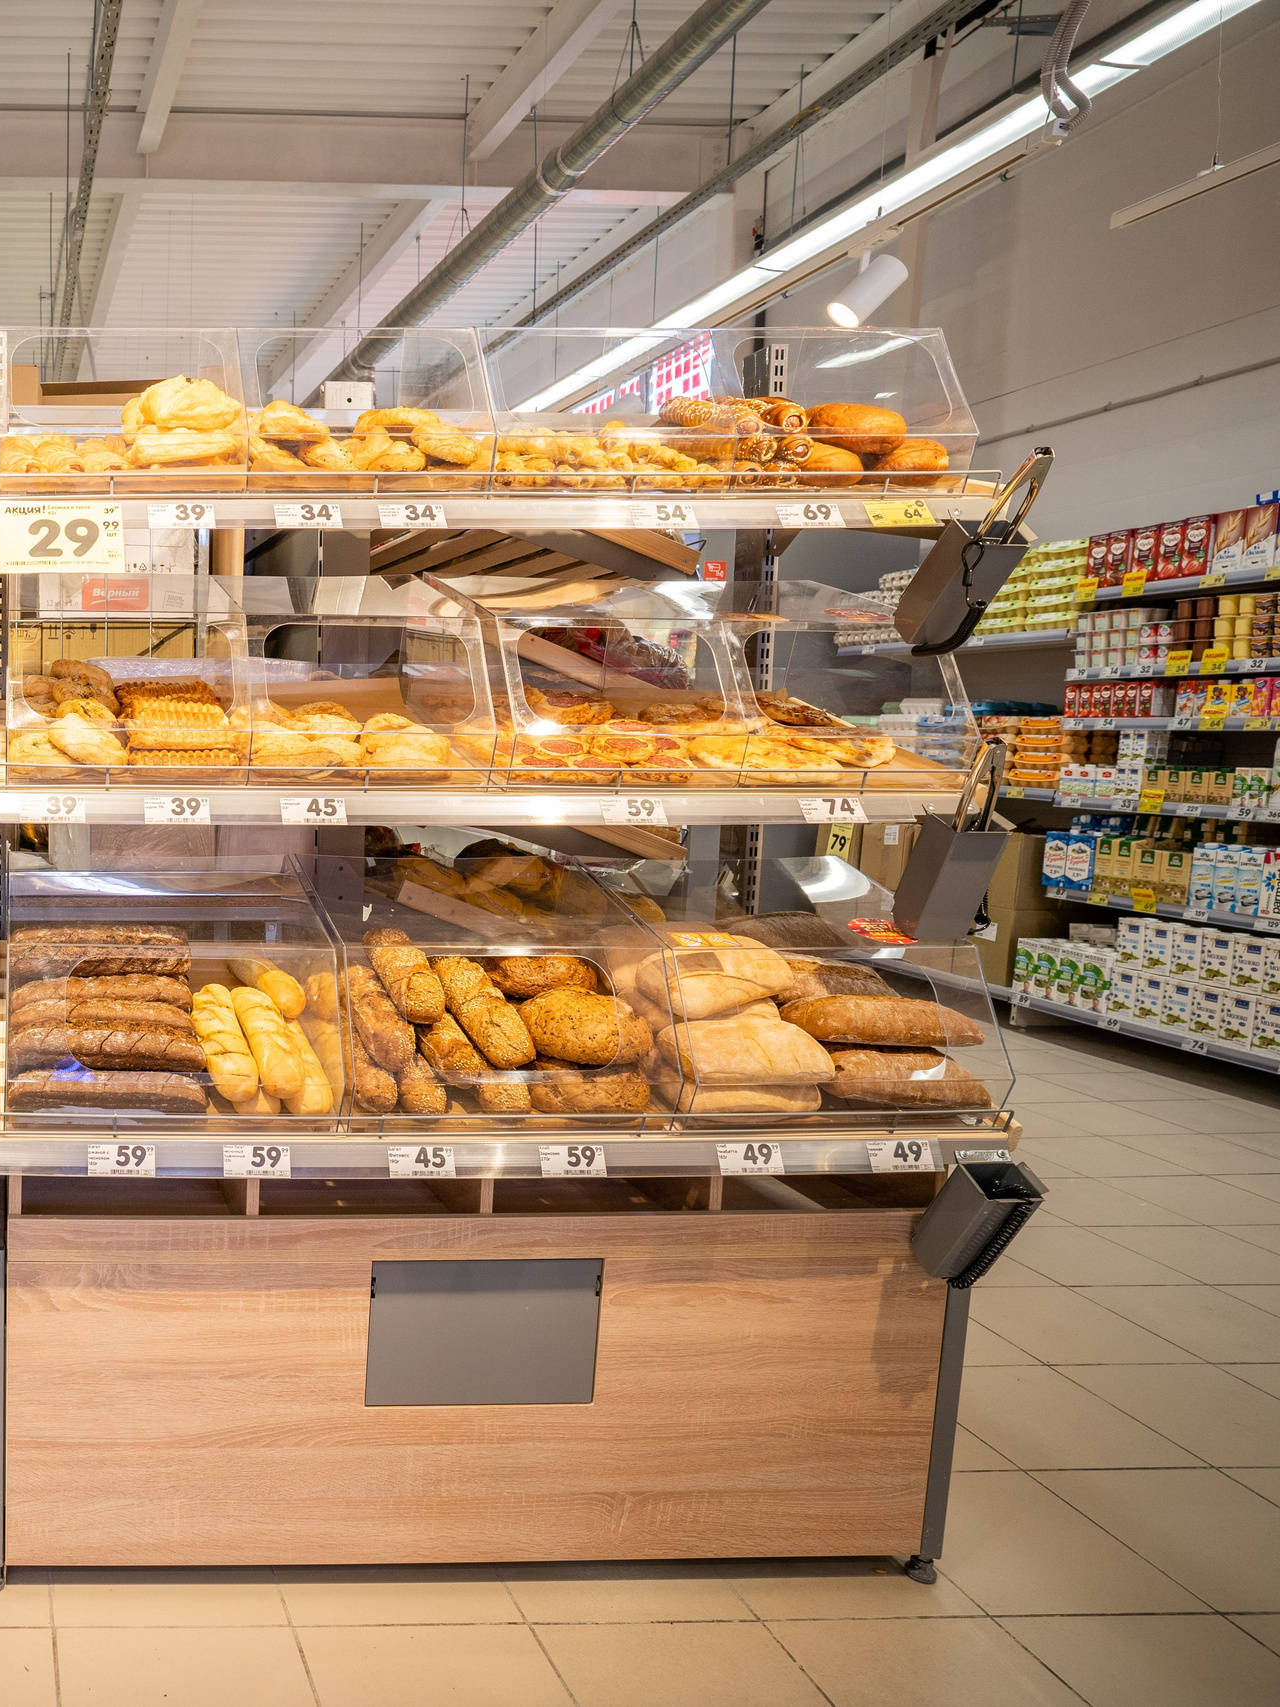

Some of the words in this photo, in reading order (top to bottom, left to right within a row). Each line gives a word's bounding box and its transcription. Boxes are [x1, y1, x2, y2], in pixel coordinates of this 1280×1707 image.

[5, 506, 46, 515] АКЦИЯ!
[175, 504, 206, 520] 39
[300, 504, 332, 520] 34
[404, 504, 436, 520] 34
[656, 504, 686, 521] 54
[803, 504, 832, 520] 69
[904, 508, 922, 518] 64
[103, 521, 119, 530] 99
[28, 518, 100, 557] 29
[92, 587, 140, 598] Верный
[1140, 666, 1151, 674] 32
[1250, 660, 1264, 668] 32
[46, 796, 76, 814] 39
[170, 798, 200, 816] 39
[306, 798, 337, 816] 45
[627, 799, 654, 816] 59
[822, 798, 855, 815] 74
[1238, 808, 1251, 816] 59
[831, 834, 846, 852] 79
[1056, 888, 1065, 896] 87
[1040, 944, 1060, 954] МОЛОКО
[1062, 950, 1083, 958] МОЛОКО
[1085, 954, 1108, 962] МОЛОКО
[1196, 1006, 1216, 1014] МОЛОКО
[1226, 1012, 1248, 1021] МОЛОКО
[1107, 1018, 1118, 1027] 69
[1192, 1040, 1205, 1050] 74
[116, 1146, 146, 1167] 59
[250, 1146, 282, 1168] 59
[414, 1146, 446, 1168] 45
[567, 1146, 596, 1168] 59
[743, 1144, 772, 1164] 49
[894, 1141, 922, 1162] 49
